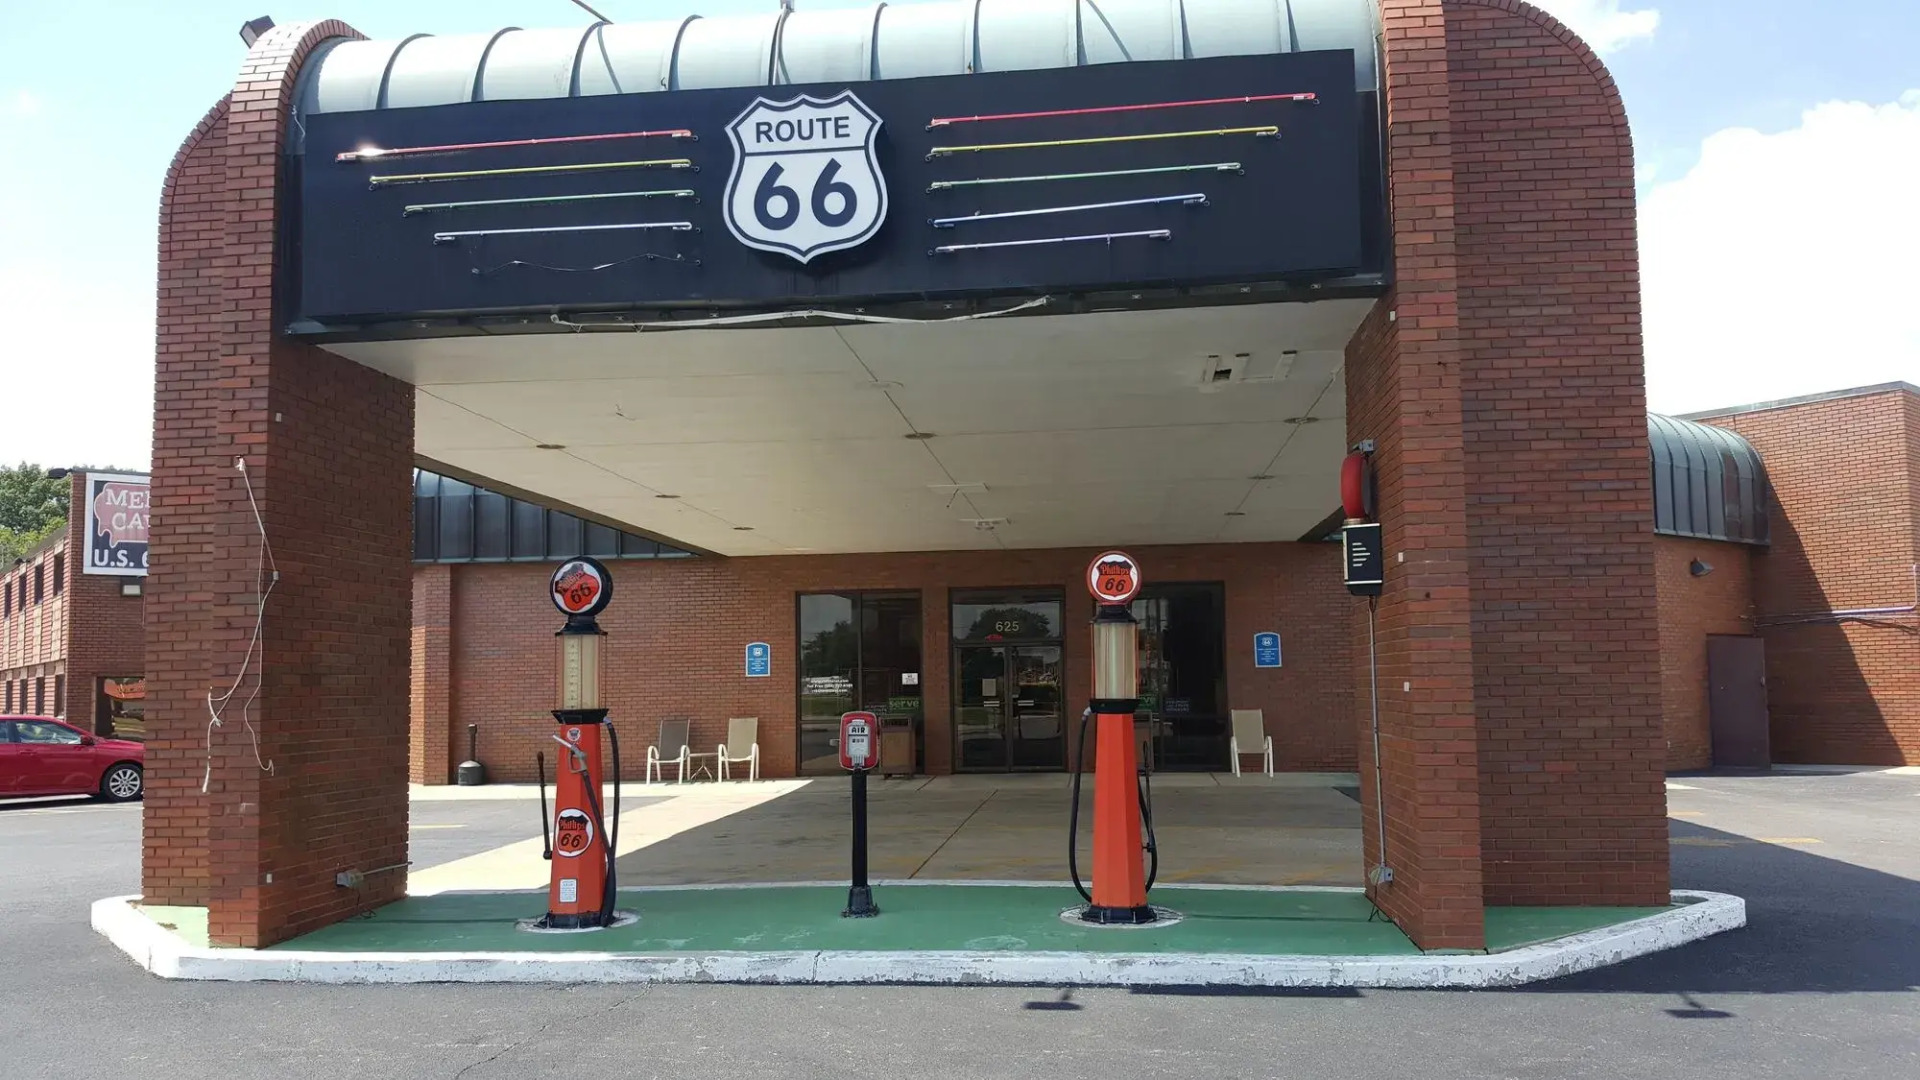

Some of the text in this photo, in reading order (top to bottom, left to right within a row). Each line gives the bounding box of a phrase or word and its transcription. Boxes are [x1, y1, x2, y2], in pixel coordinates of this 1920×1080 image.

[755, 116, 851, 144] ROUTE
[753, 157, 858, 231] 66
[94, 549, 135, 567] U.S.
[1101, 563, 1129, 576] Phillips
[571, 582, 592, 604] 66
[1105, 578, 1127, 592] 66
[995, 621, 1020, 632] 625
[561, 833, 582, 848] 66
